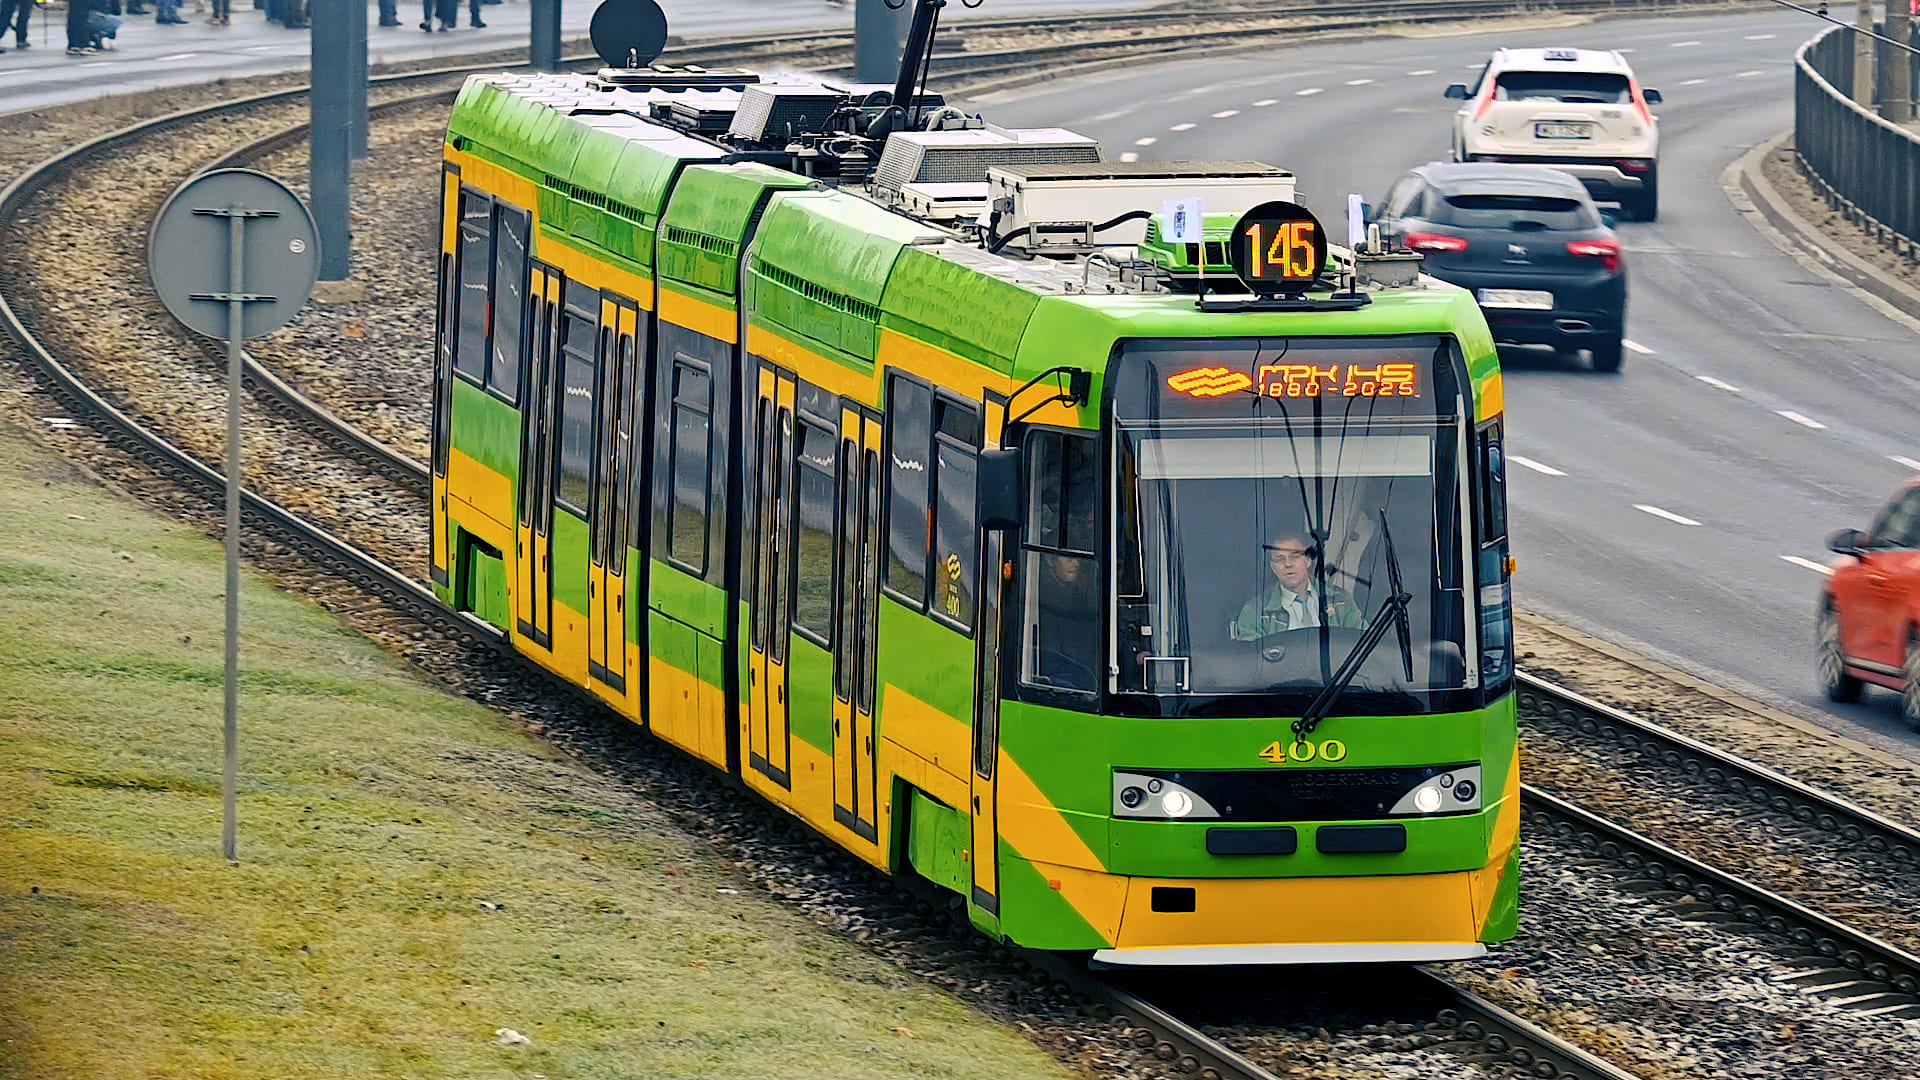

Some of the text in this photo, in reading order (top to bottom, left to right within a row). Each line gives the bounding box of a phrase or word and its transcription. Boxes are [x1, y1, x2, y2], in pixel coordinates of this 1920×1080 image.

[1245, 222, 1315, 278] 145
[1347, 363, 1416, 383] 145
[1258, 739, 1347, 763] 400
